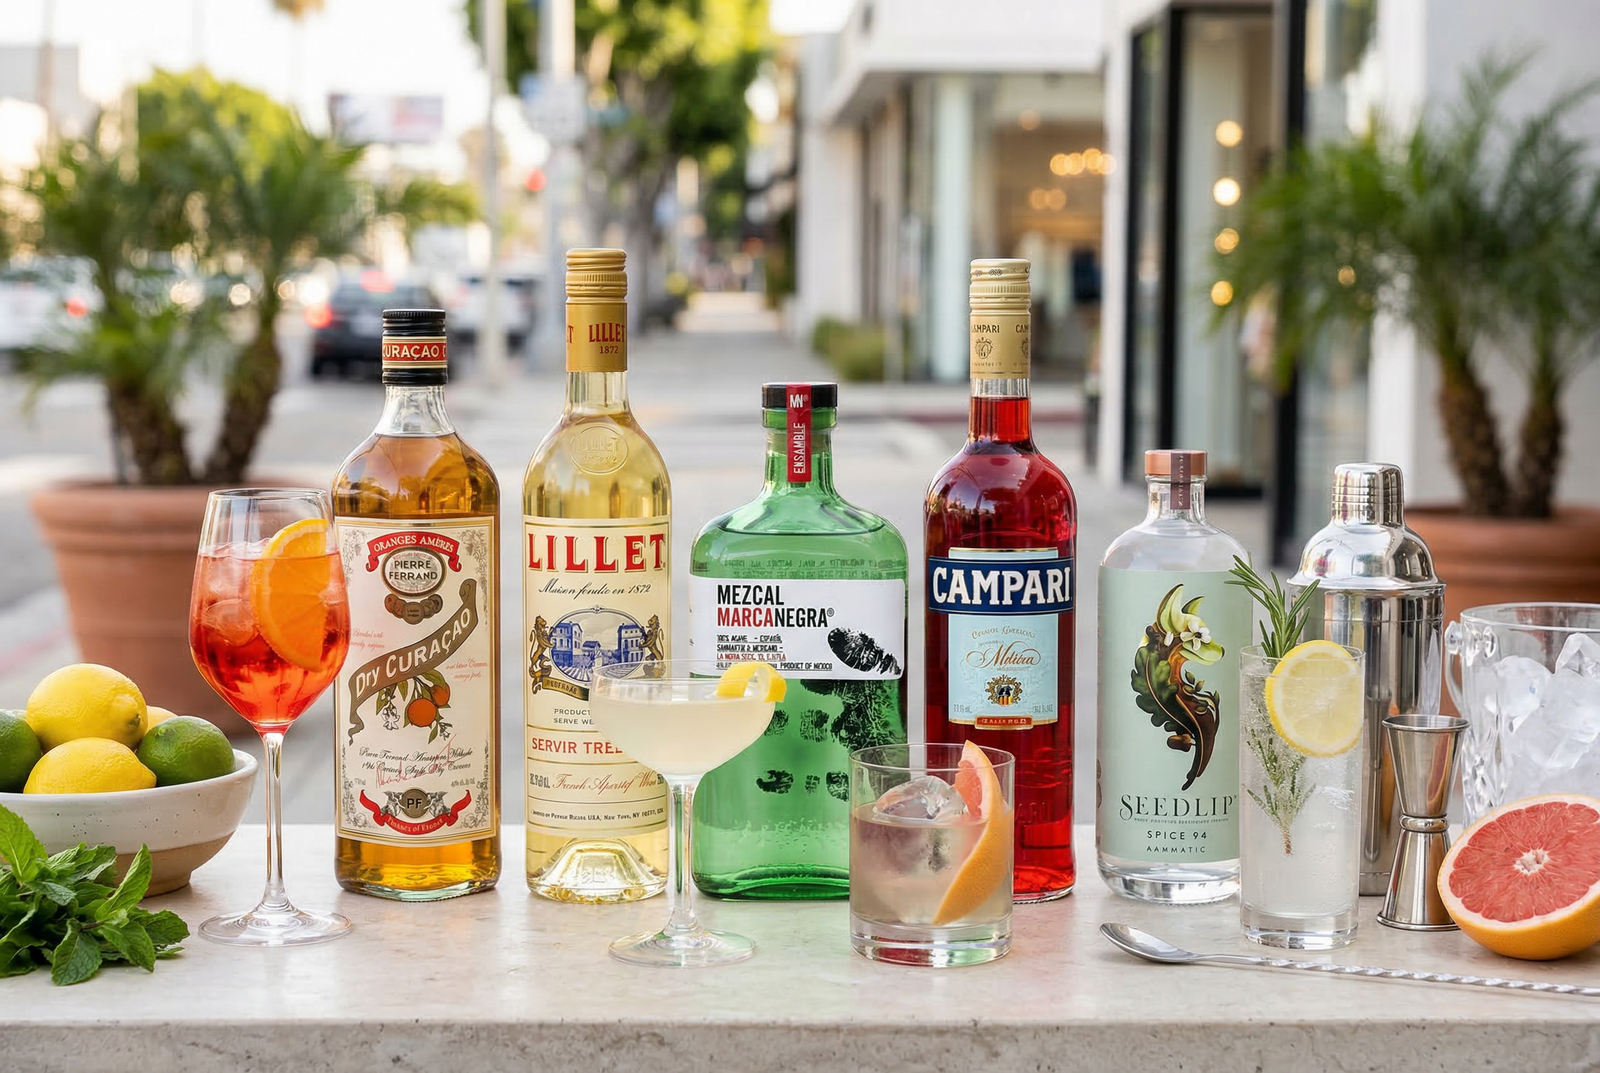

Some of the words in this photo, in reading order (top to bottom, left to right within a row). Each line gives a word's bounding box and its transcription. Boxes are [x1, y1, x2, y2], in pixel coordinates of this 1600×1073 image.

[599, 345, 619, 354] 1872
[793, 422, 806, 474] ENSAMBLE
[373, 535, 417, 552] ORANGES
[528, 533, 665, 573] LILLET
[394, 560, 432, 569] PIERRE
[389, 571, 438, 580] FERRAND
[627, 583, 652, 595] 1872
[717, 584, 785, 605] MEZCAL
[932, 566, 1071, 606] CAMPARI
[356, 666, 380, 698] Dry
[385, 607, 471, 679] CURAÇAO
[553, 717, 579, 725] SERVE
[531, 737, 578, 754] SERVIR
[406, 798, 423, 809] PF
[1119, 793, 1233, 821] SEEDLIP
[1146, 830, 1186, 840] SPICE
[1192, 831, 1208, 840] 94
